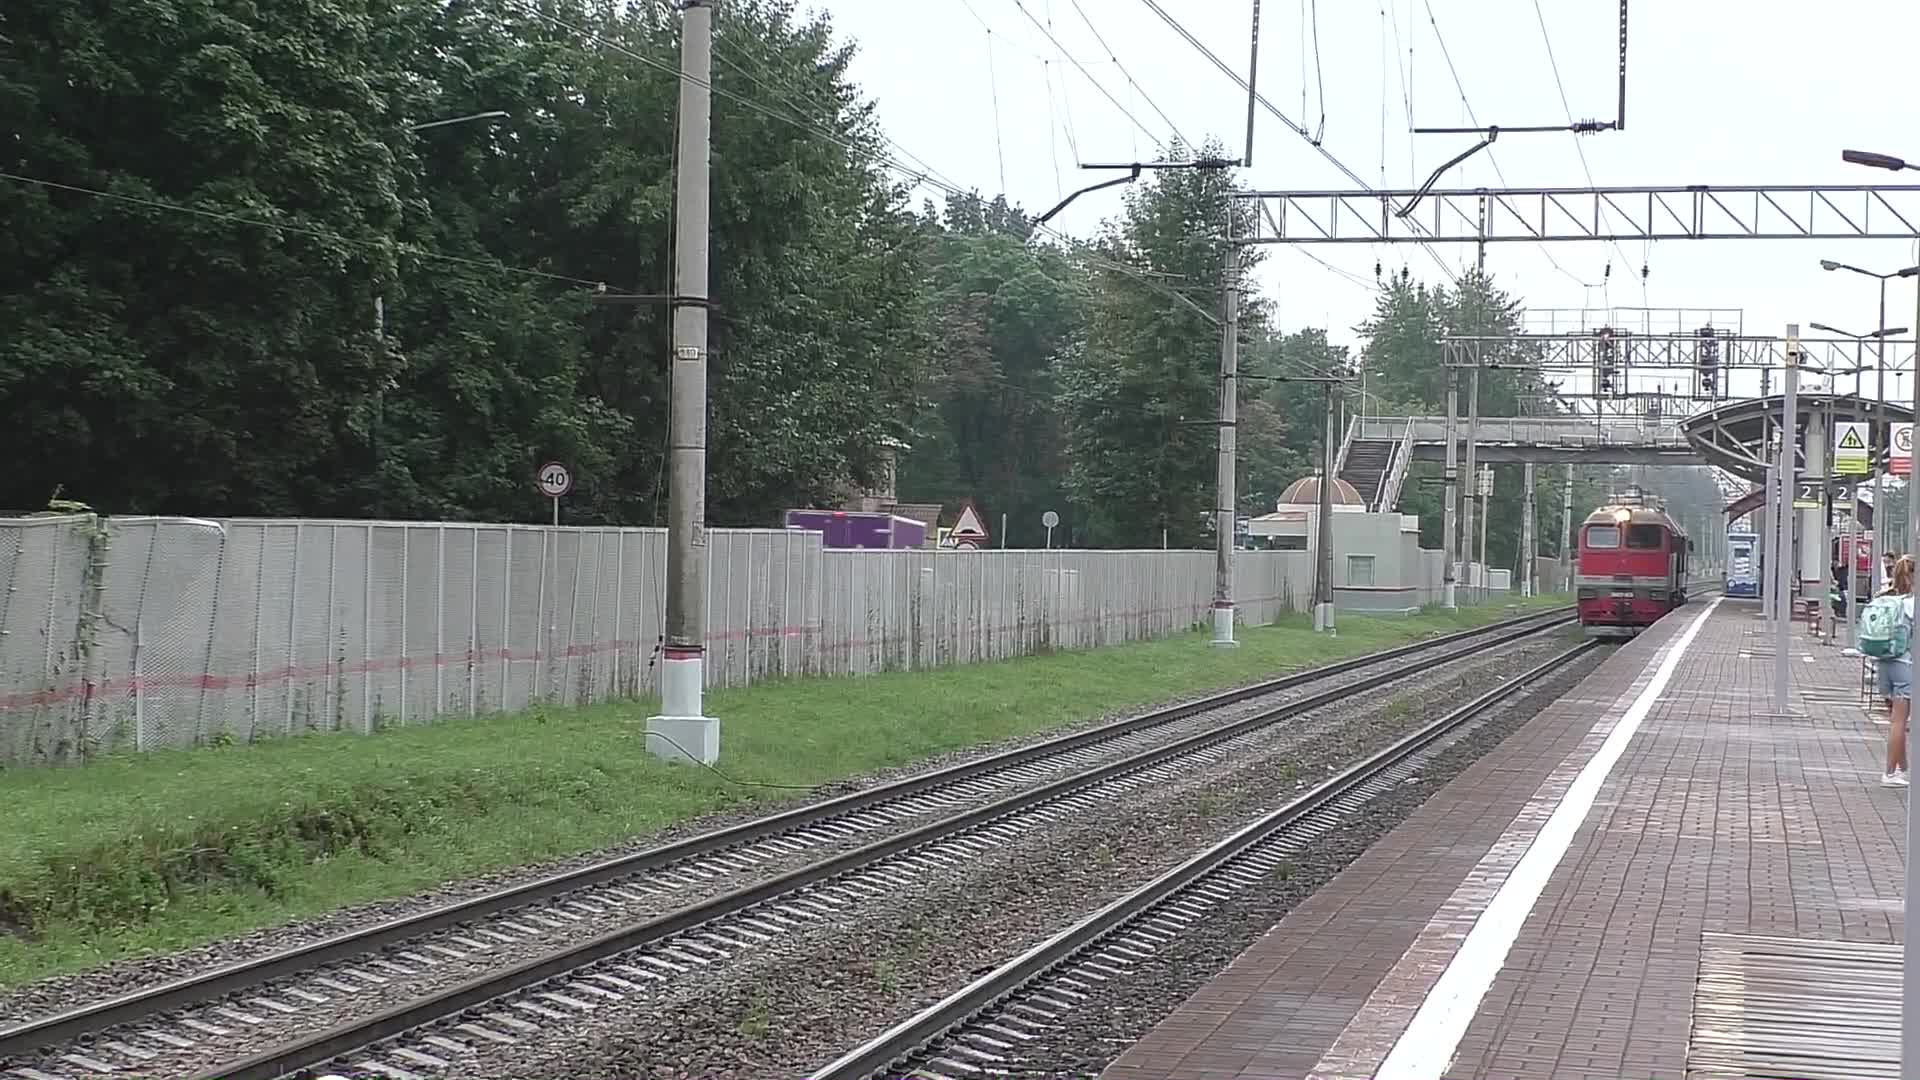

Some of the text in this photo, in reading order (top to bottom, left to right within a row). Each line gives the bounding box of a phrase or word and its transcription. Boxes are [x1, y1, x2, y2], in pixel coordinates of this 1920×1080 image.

[544, 472, 565, 486] 40
[1802, 485, 1812, 499] 2
[1838, 486, 1848, 500] 2
